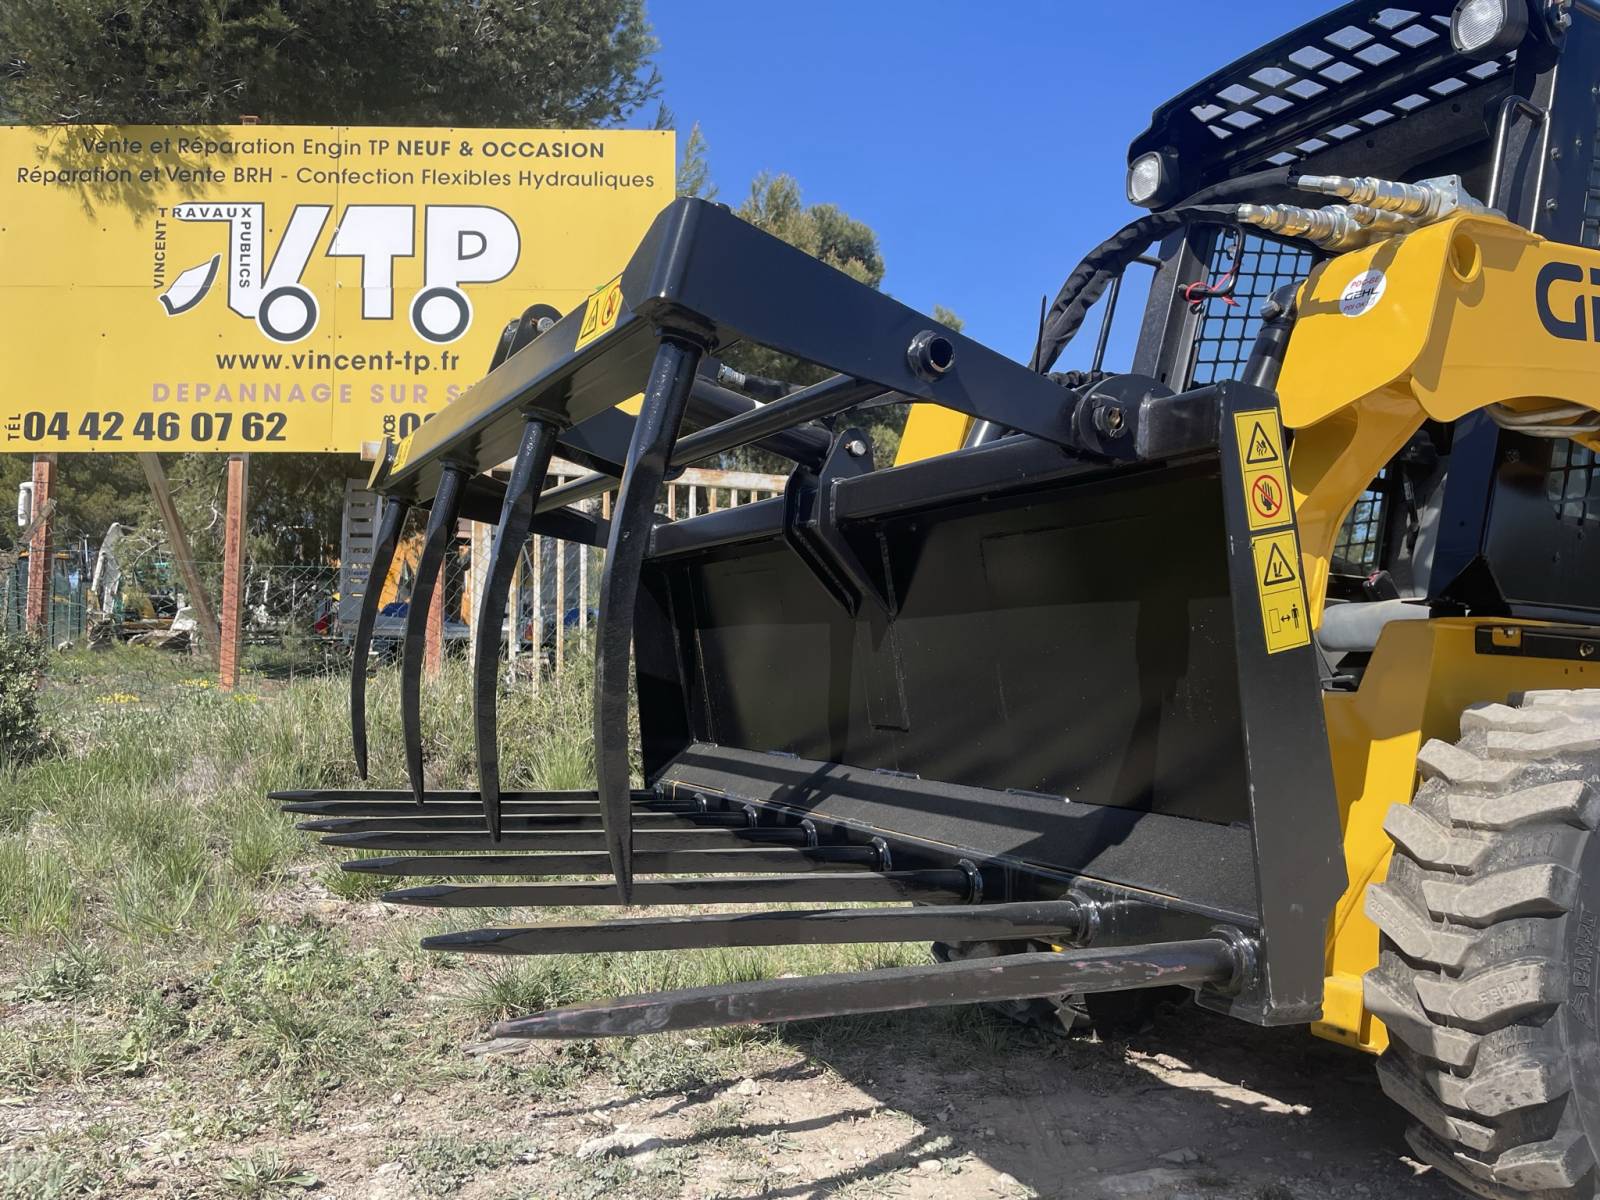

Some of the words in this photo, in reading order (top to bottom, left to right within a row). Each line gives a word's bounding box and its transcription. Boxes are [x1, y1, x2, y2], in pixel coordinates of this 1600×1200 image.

[83, 137, 142, 154] Vente
[151, 138, 171, 154] et
[178, 136, 295, 157] Réparation
[303, 139, 361, 159] Engin
[369, 140, 390, 156] TP
[397, 140, 451, 156] NEUF
[459, 141, 474, 157] &
[482, 142, 604, 158] OCCASION
[17, 166, 132, 186] Réparation
[140, 166, 160, 182] et
[166, 168, 226, 183] Vente
[235, 168, 272, 183] BRH
[296, 168, 414, 184] Confection
[422, 169, 511, 186] Flexibles
[519, 171, 654, 190] Hydrauliques
[158, 207, 252, 218] TRAVAUX
[153, 220, 167, 289] VINCENT
[239, 221, 251, 288] PUBLICS
[1344, 287, 1379, 301] GEHL
[216, 350, 460, 374] www.vincent-tp.fr
[152, 383, 352, 402] DEPANNAGE
[371, 384, 428, 404] SUR
[5, 413, 21, 441] TÉL
[23, 411, 70, 441] 04
[78, 411, 125, 441] 42
[133, 411, 180, 441] 46
[191, 412, 233, 441] 07
[241, 412, 288, 441] 62
[399, 412, 437, 440] 0
